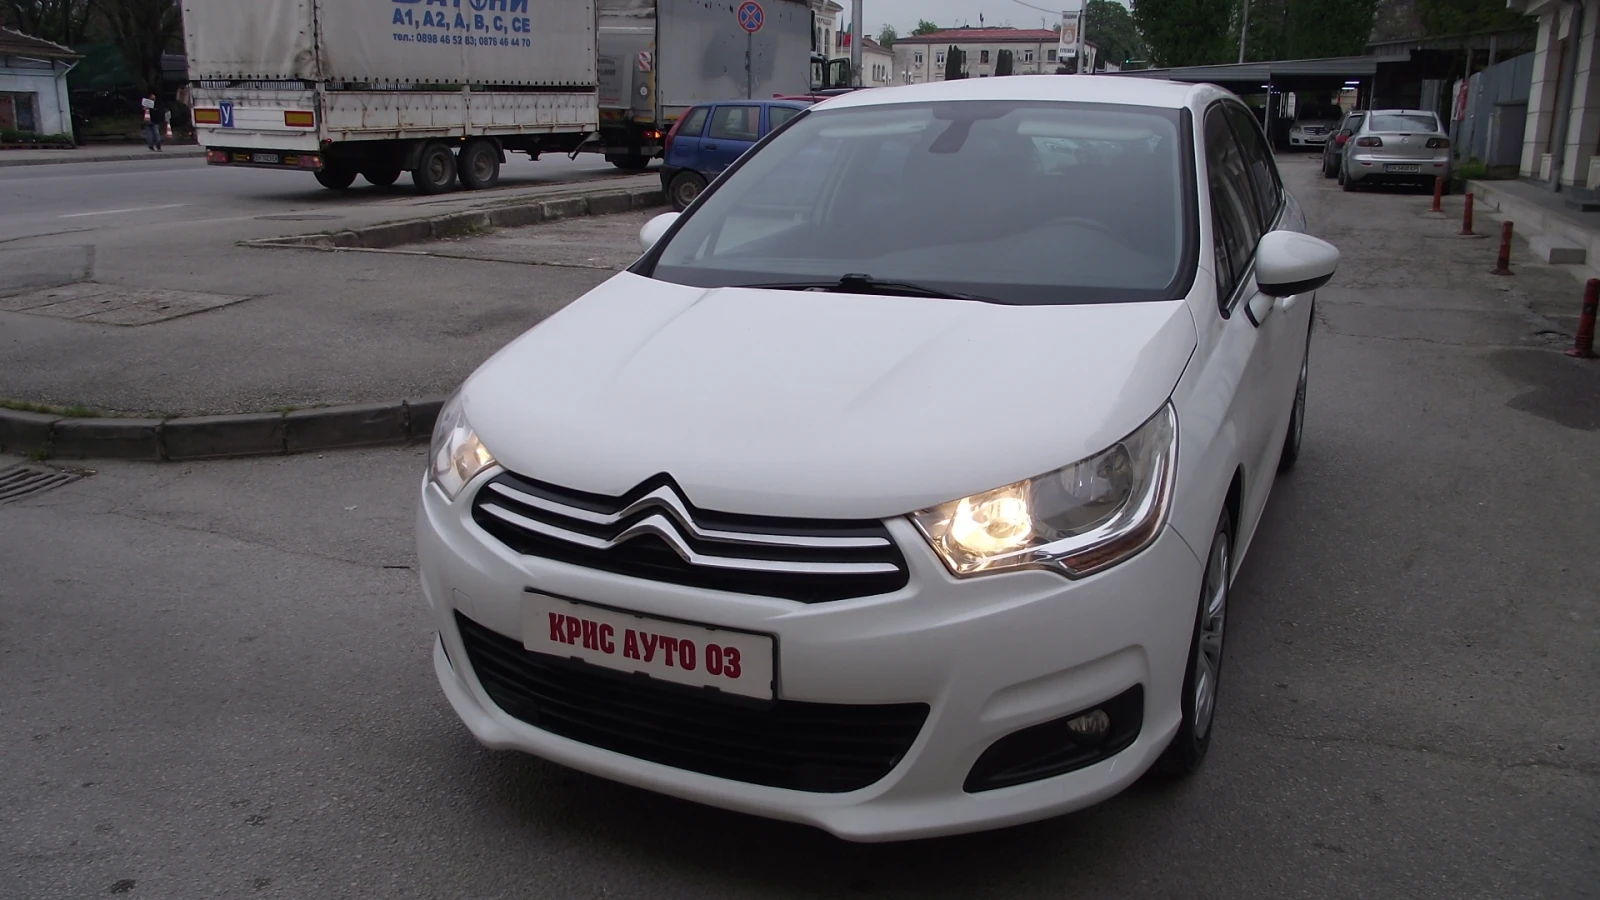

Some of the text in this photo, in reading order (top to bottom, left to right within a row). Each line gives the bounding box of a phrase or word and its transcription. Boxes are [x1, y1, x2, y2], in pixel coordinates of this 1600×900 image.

[393, 8, 530, 35] A1, A2, A, B, C, CE
[416, 33, 438, 44] 0898
[440, 35, 450, 44] 46
[453, 35, 462, 45] 52
[479, 37, 497, 46] 0876
[500, 38, 508, 47] 46
[521, 38, 530, 47] 70
[549, 612, 615, 654] КРИС
[623, 629, 696, 671] АУТО
